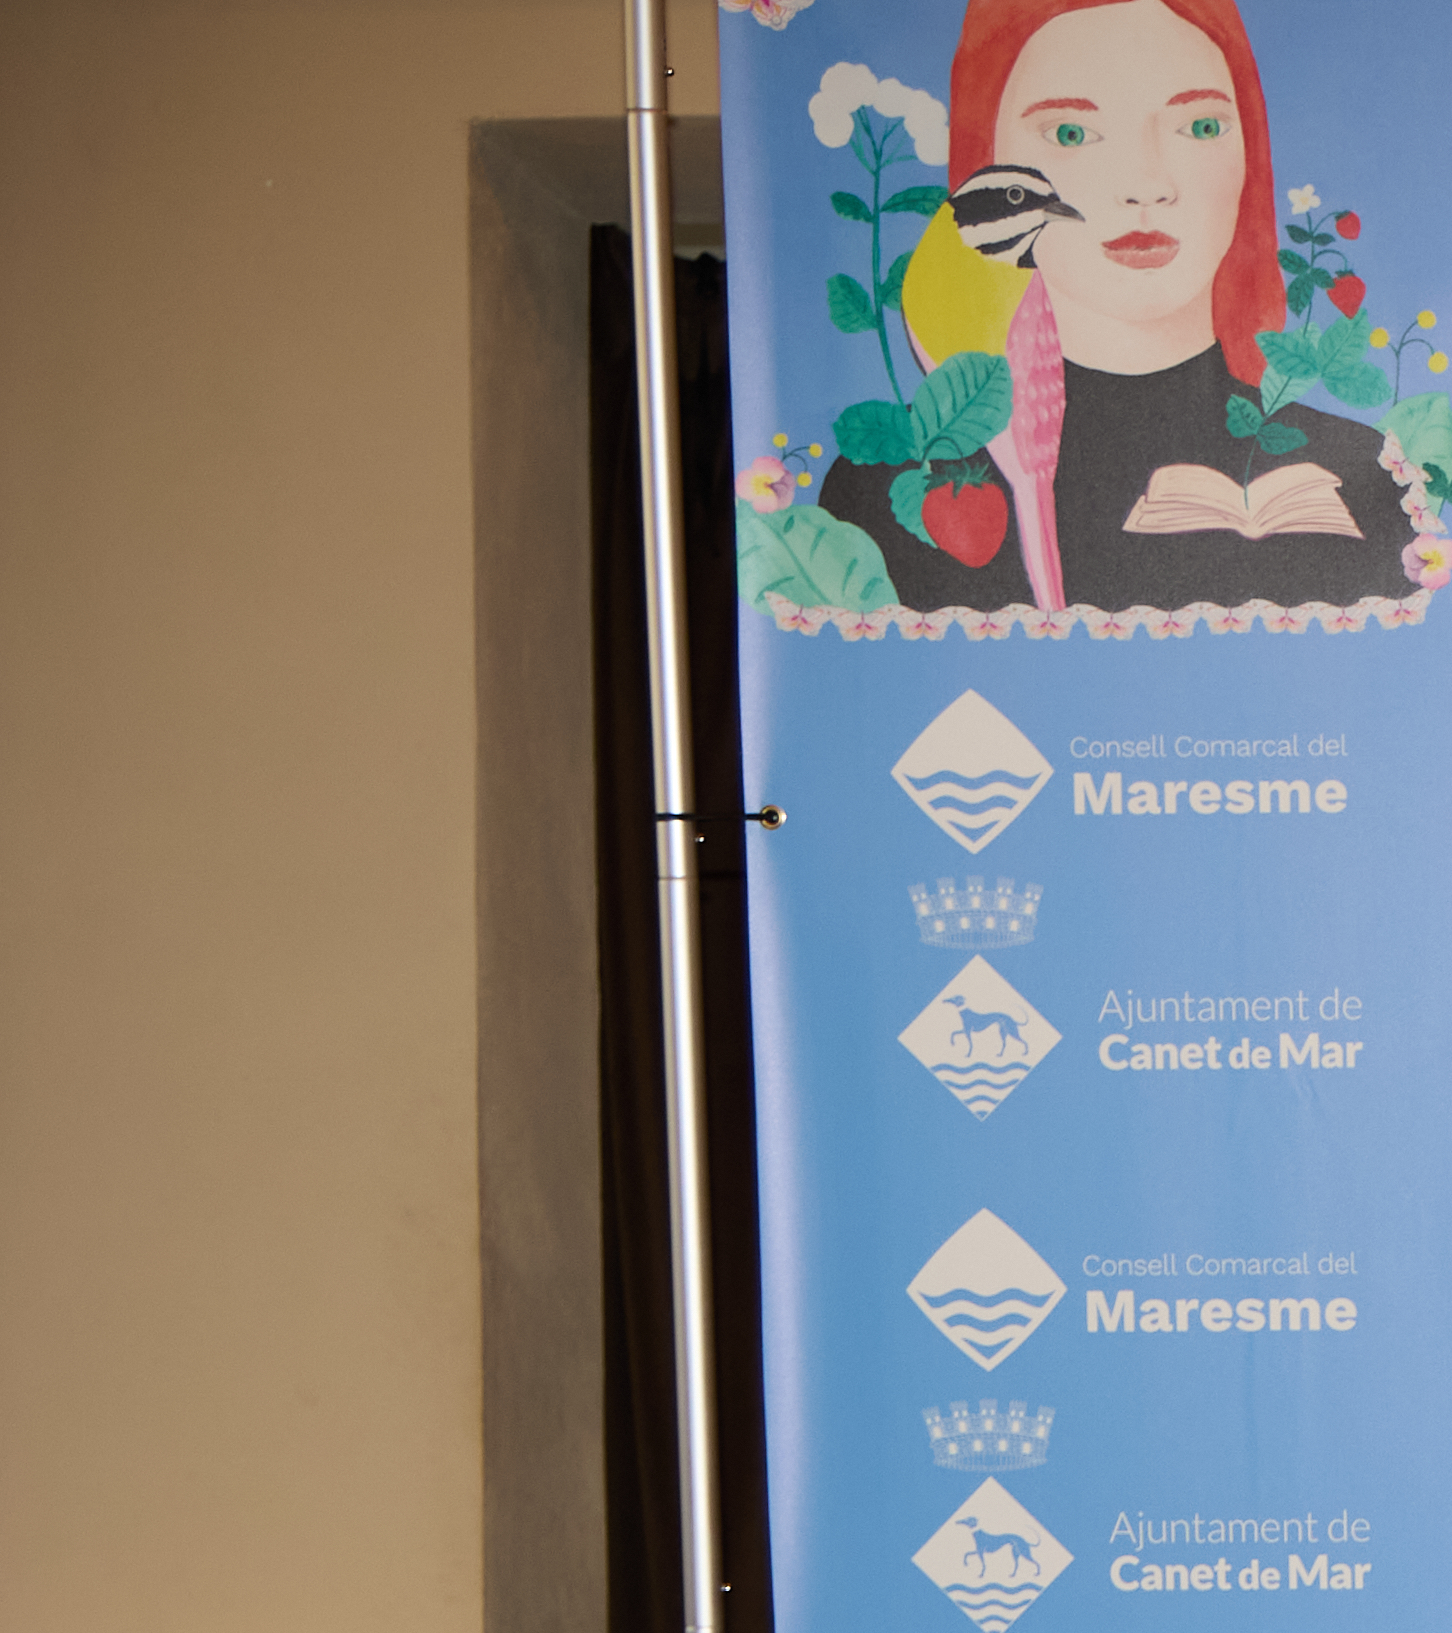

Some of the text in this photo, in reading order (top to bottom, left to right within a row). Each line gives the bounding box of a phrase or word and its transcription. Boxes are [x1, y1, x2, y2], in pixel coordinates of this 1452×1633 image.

[1071, 736, 1346, 757] Consell Comarcal del
[1073, 771, 1347, 815] Maresme
[1099, 989, 1362, 1029] Ajuntament de
[1098, 1032, 1363, 1070] Canet de Mar
[1110, 1510, 1370, 1551] Ajuntament de
[1110, 1554, 1372, 1591] Canet de Mar
